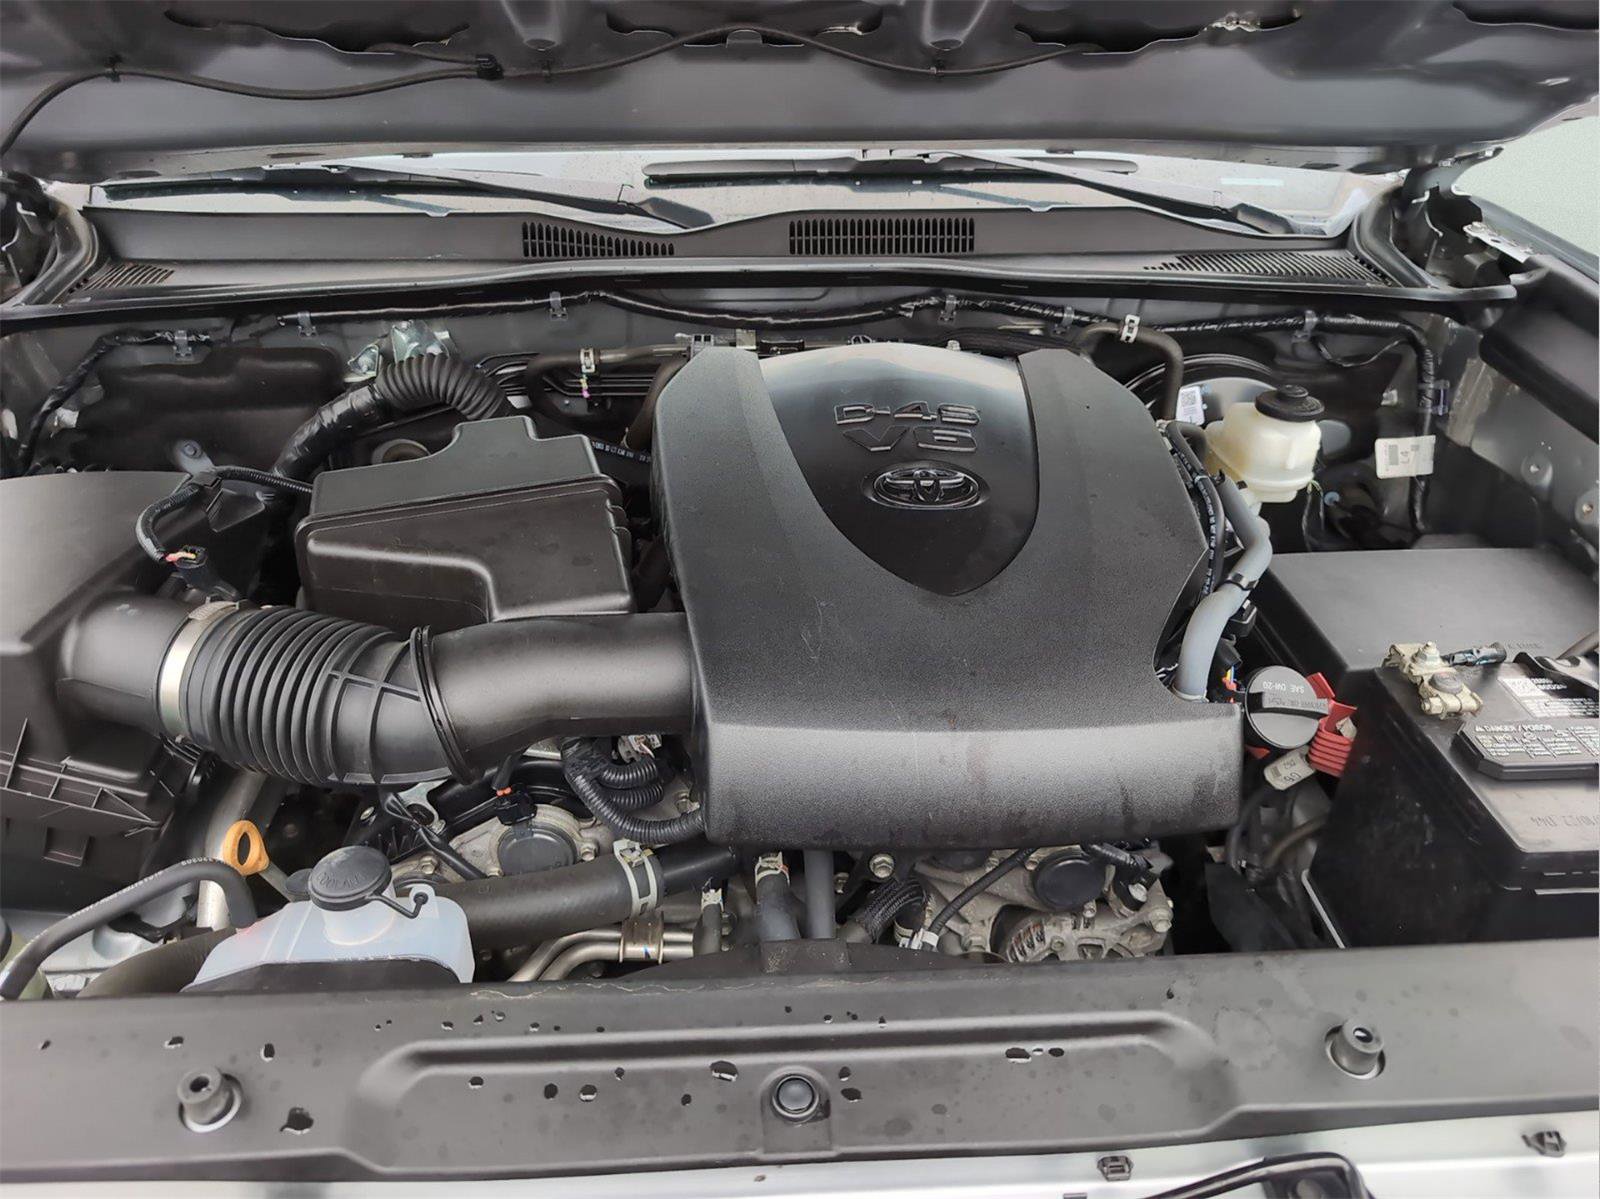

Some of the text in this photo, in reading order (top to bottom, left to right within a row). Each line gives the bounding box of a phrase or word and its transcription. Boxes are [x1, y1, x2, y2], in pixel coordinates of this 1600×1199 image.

[833, 400, 981, 425] D-4S
[842, 424, 978, 452] V6
[1289, 684, 1305, 694] SAE
